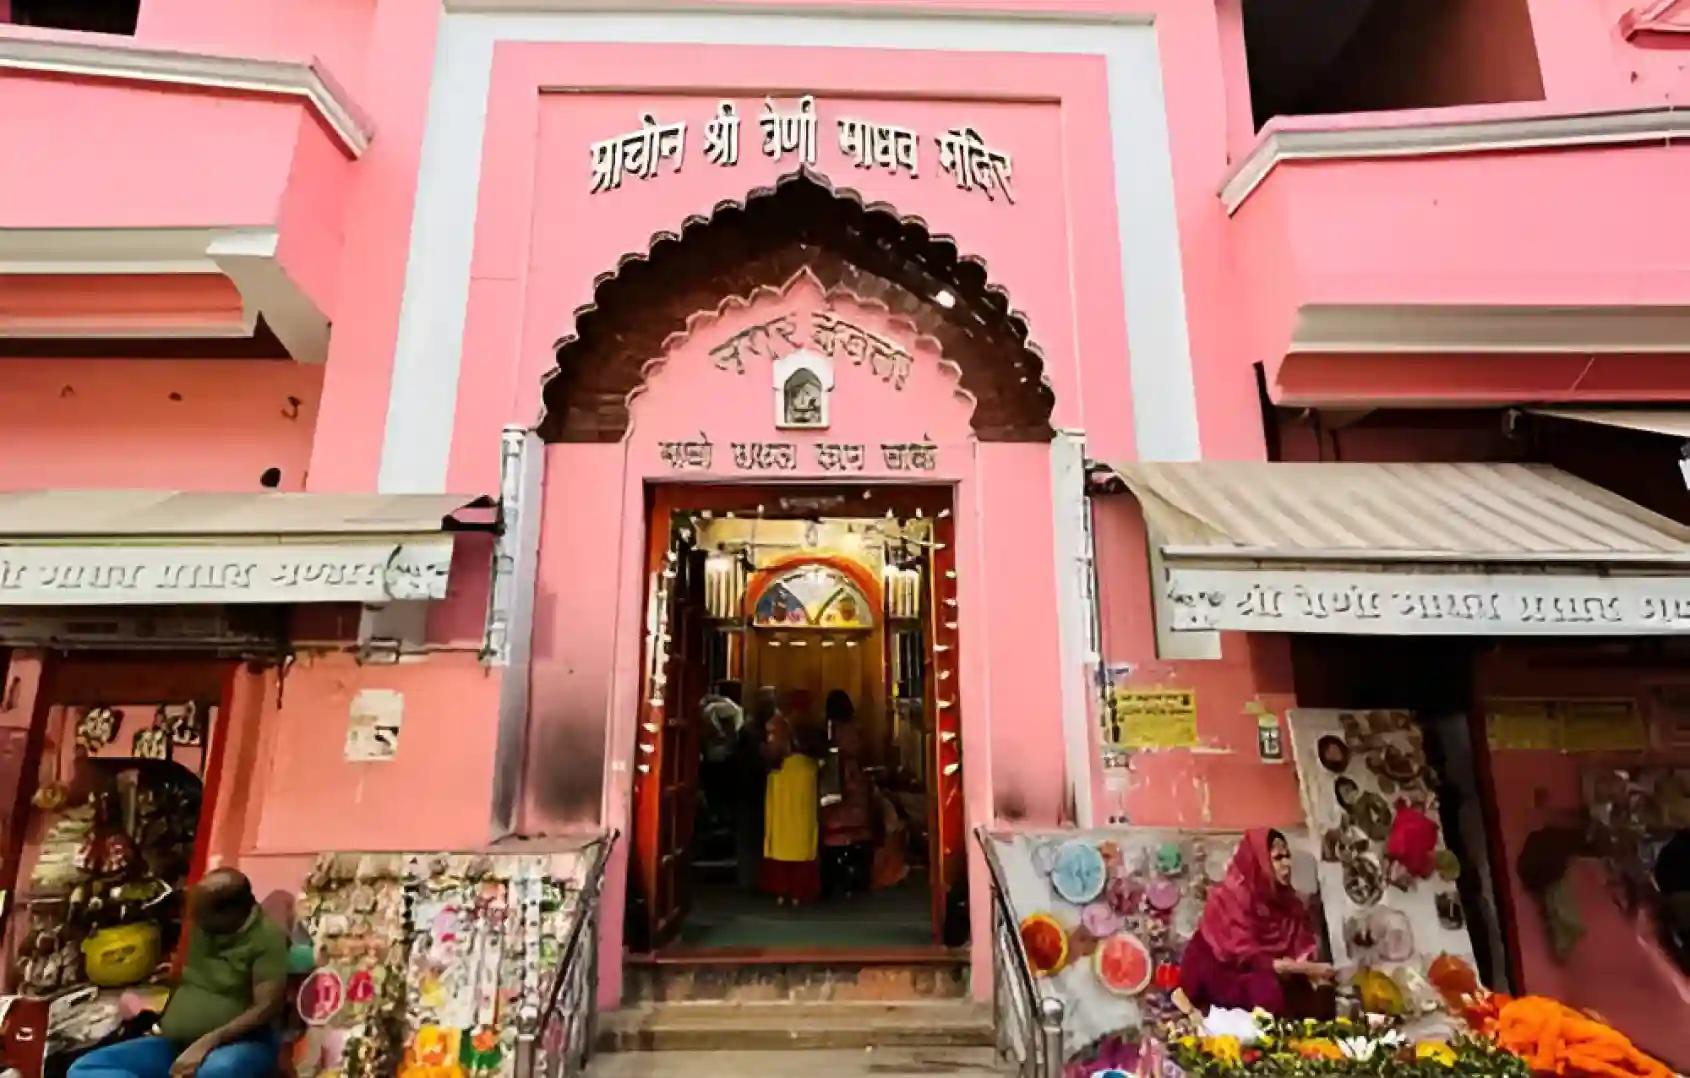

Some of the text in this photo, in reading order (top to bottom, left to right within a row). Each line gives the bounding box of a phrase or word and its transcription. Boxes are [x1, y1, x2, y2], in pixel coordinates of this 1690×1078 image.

[589, 95, 1016, 205] प्राचीन श्री वेणी माधव मंदिर
